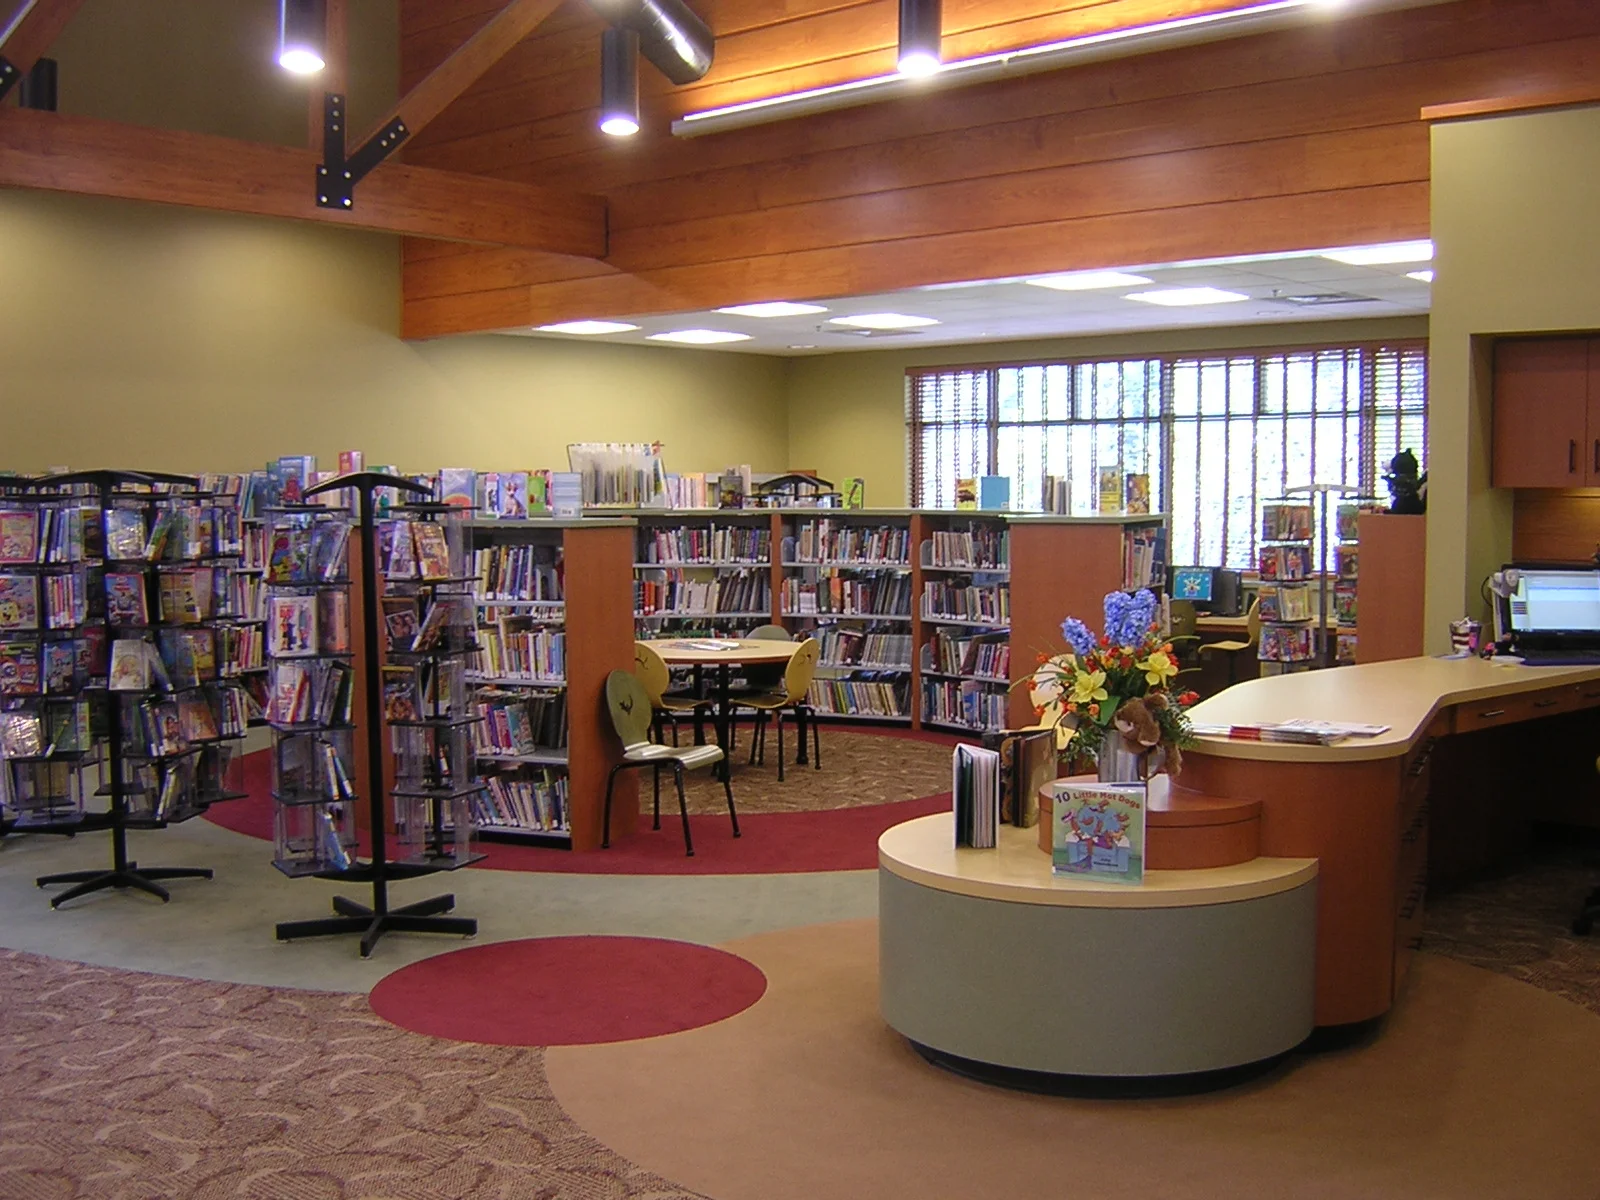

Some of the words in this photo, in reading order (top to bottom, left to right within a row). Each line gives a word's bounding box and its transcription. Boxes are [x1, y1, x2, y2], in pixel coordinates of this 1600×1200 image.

[1055, 791, 1071, 804] 10
[1073, 791, 1097, 800] Little
[1100, 792, 1116, 800] Hot
[1118, 795, 1140, 809] Dogs
